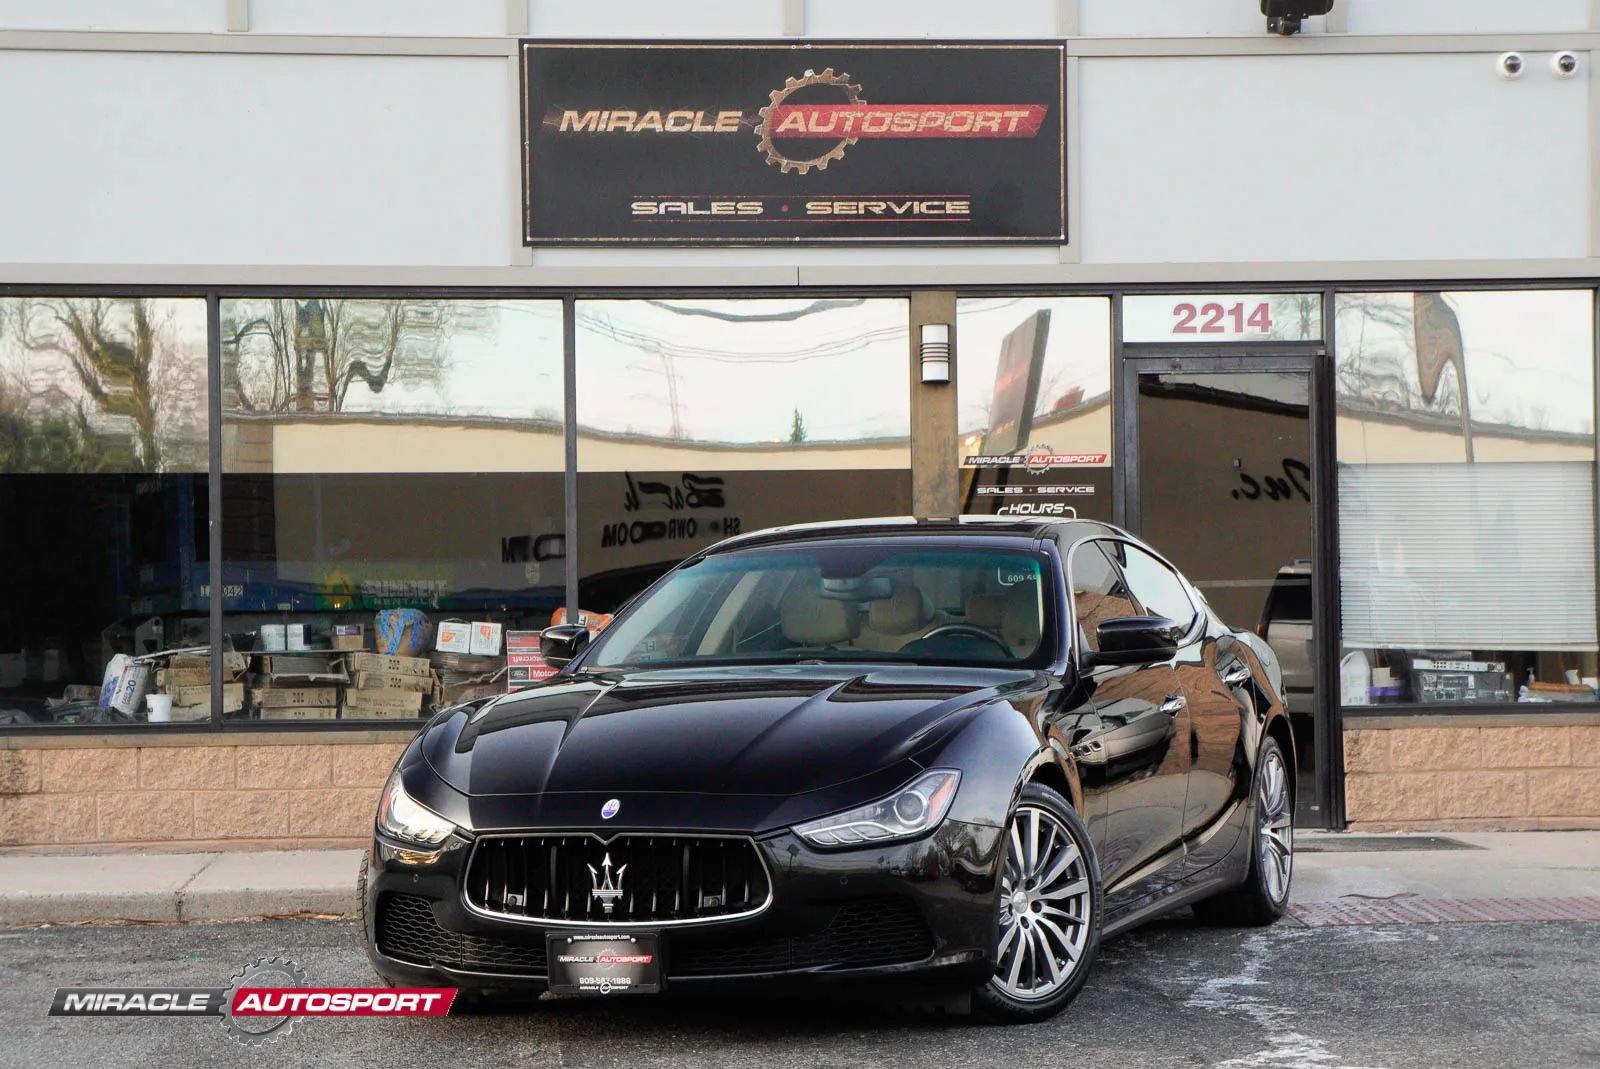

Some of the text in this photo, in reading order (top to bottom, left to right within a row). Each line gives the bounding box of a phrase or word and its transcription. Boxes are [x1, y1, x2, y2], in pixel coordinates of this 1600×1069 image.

[560, 110, 1030, 133] MIRACLE AUTOSPORT
[631, 201, 970, 215] SALES SERVICE
[1172, 303, 1273, 334] 2214
[968, 454, 1103, 465] MIRACLE AUTOSPORT
[977, 485, 1095, 495] SALES SERVICE
[1009, 503, 1065, 515] HOURS
[125, 680, 137, 693] 20
